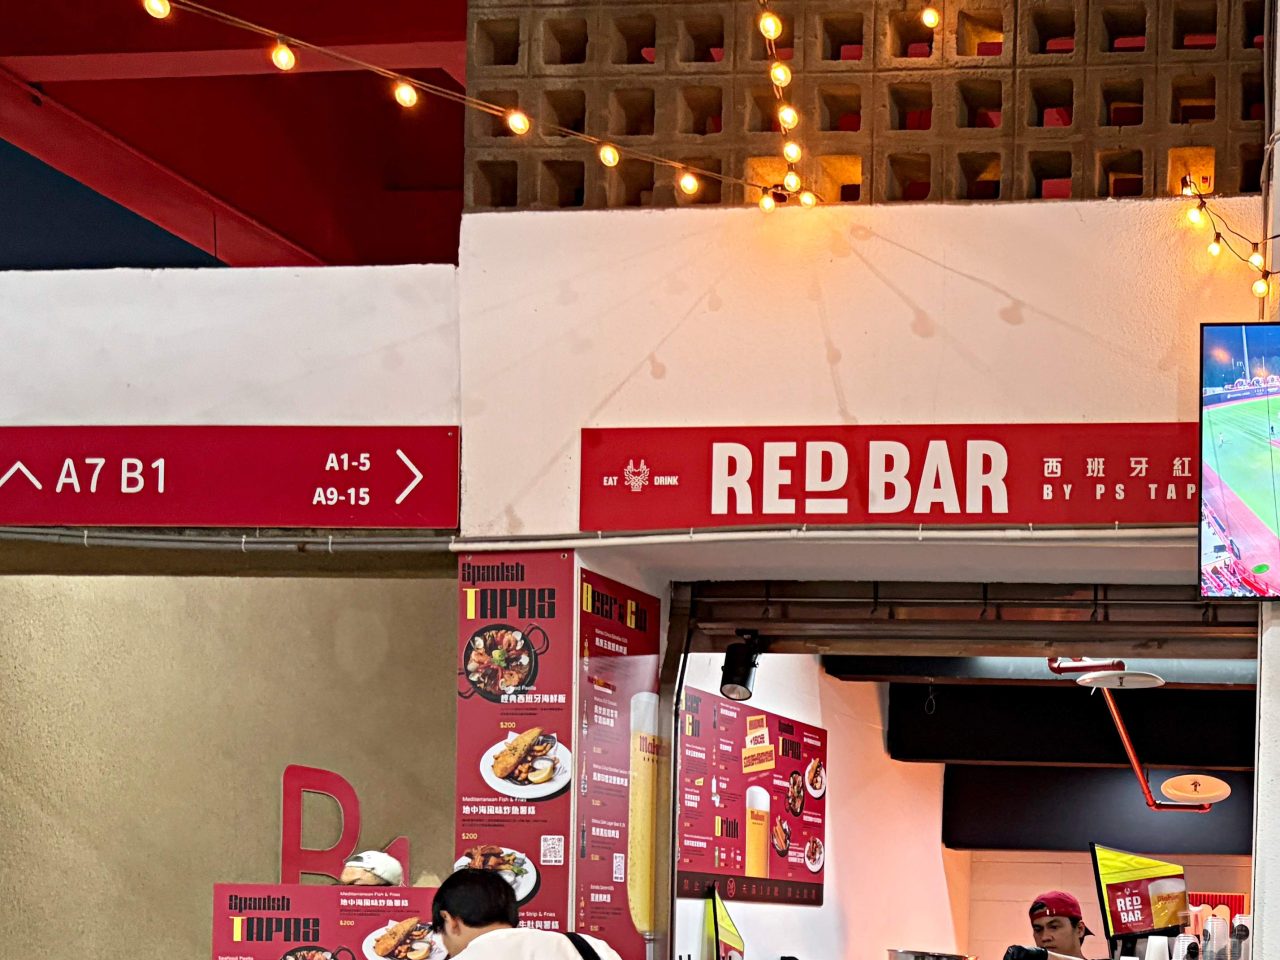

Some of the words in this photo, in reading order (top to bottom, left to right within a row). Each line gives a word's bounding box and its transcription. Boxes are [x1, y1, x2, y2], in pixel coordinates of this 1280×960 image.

[325, 453, 371, 472] A1-5
[1043, 457, 1193, 478] 西班牙紅
[56, 458, 105, 493] A7
[121, 458, 166, 493] B1
[603, 475, 618, 486] EAT
[654, 475, 679, 486] DRINK
[711, 442, 848, 514] RED
[868, 439, 1009, 514] BAR
[312, 487, 371, 506] A9-15
[1043, 484, 1072, 499] BY
[1096, 484, 1125, 499] PS
[1149, 484, 1198, 500] TAP
[462, 562, 525, 585] Spanish
[463, 588, 556, 619] TAPAS
[500, 721, 516, 729] $200
[229, 894, 291, 913] Spanish
[1116, 895, 1143, 912] RED
[1120, 910, 1142, 924] BAR
[229, 916, 320, 942] TAPAS
